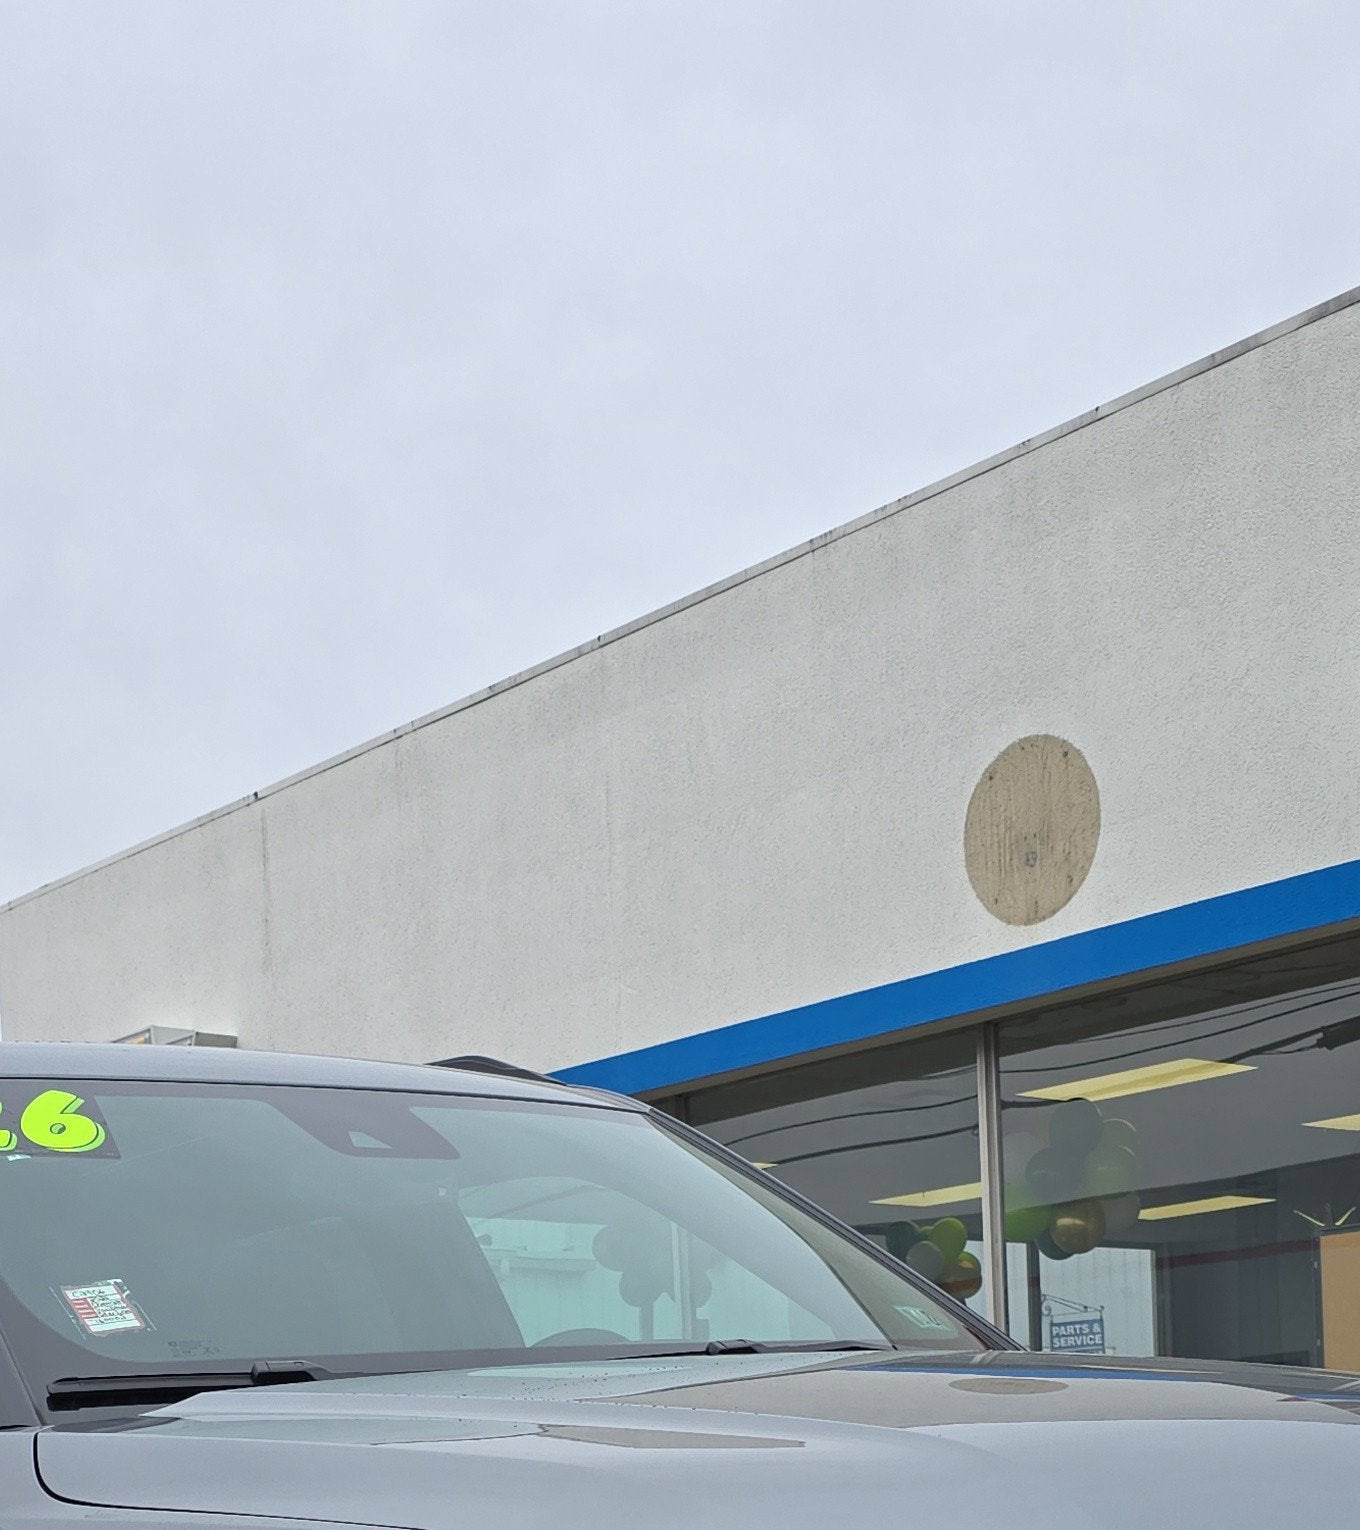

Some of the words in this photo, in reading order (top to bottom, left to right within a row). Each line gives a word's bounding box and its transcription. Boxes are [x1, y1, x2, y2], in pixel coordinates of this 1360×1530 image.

[1053, 1324, 1089, 1335] PARTS
[1093, 1323, 1101, 1333] &
[1053, 1334, 1102, 1347] SERVICE
